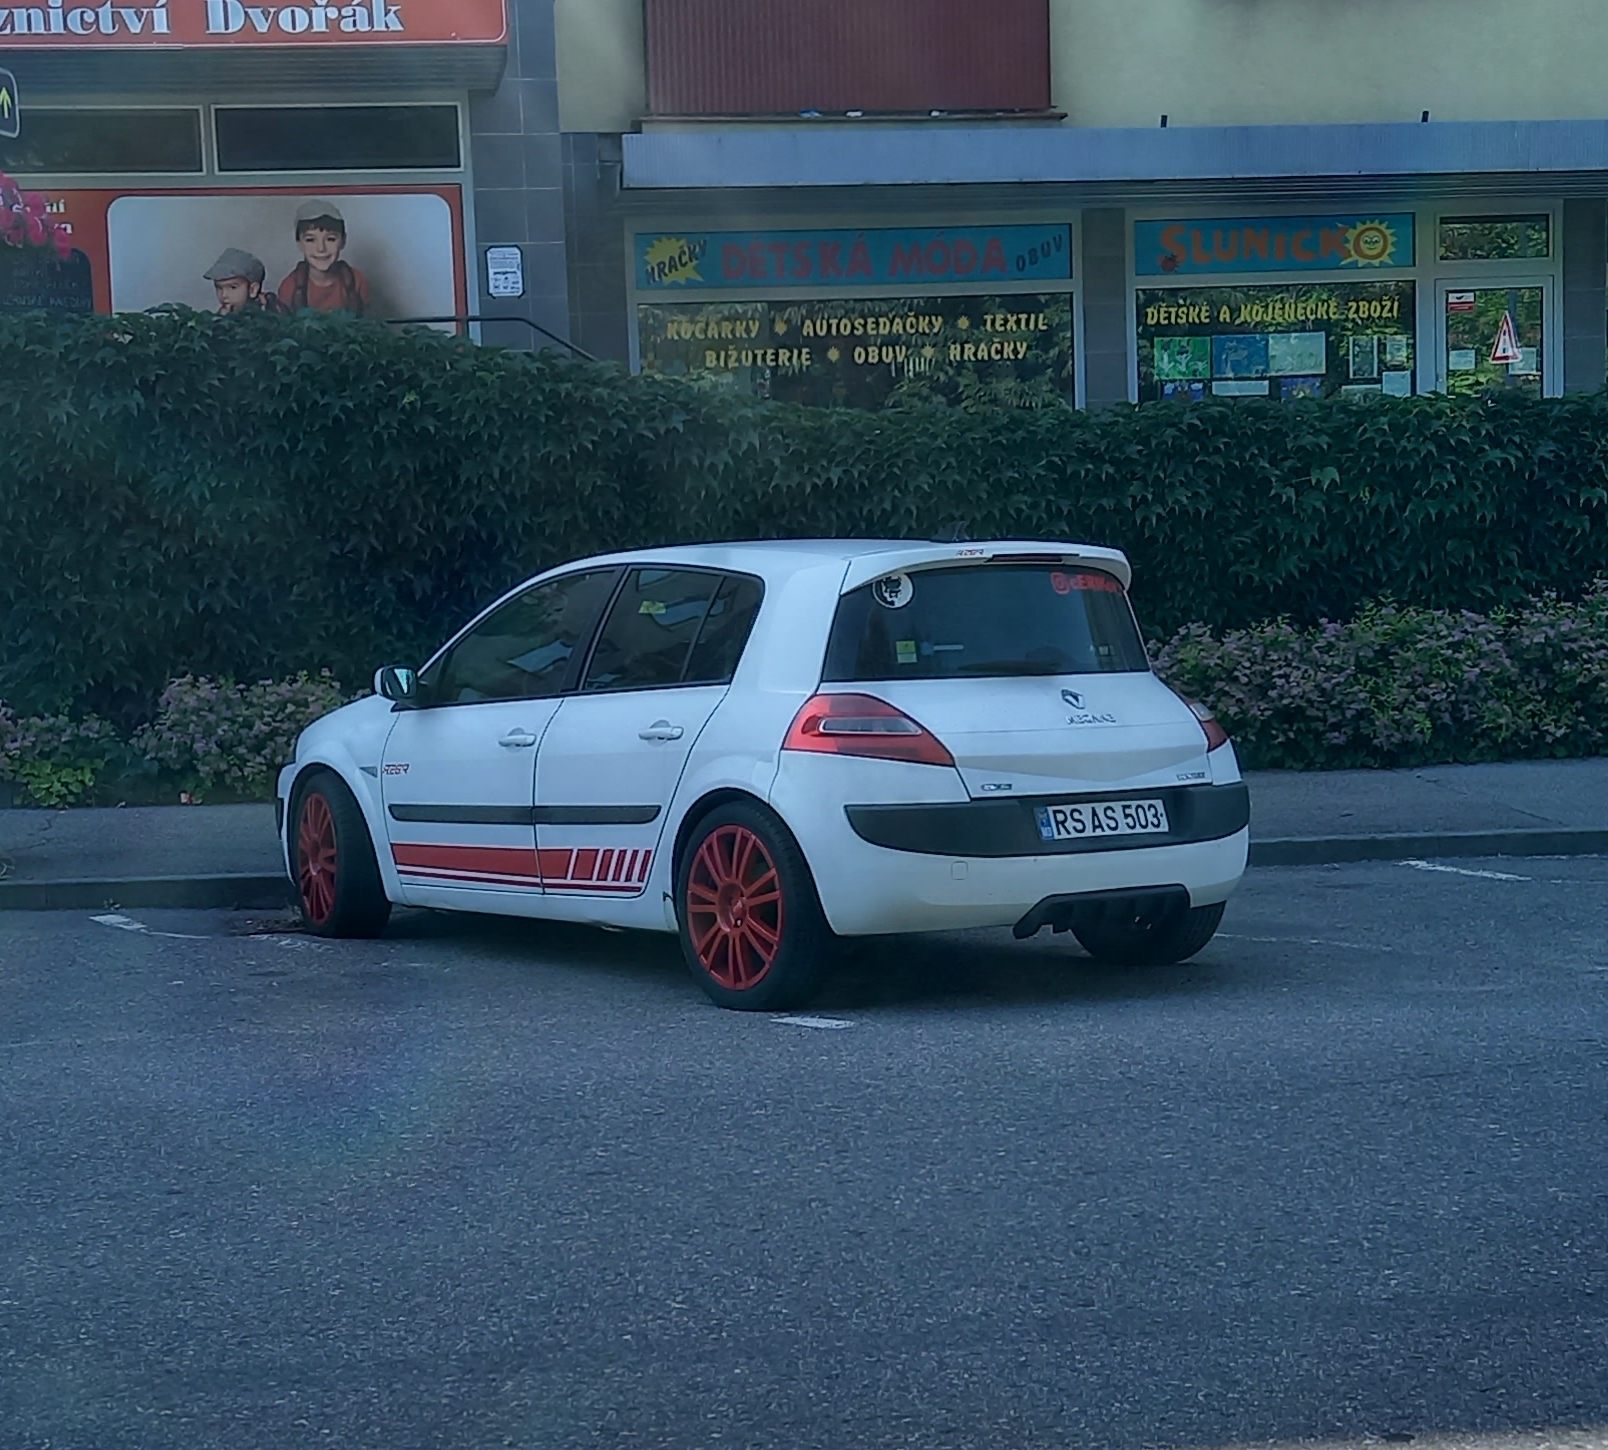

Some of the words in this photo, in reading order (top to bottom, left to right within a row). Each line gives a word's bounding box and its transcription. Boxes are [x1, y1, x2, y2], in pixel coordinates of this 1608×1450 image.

[206, 0, 404, 34] Dvořák
[645, 237, 708, 285] HRAČKY
[888, 231, 1008, 277] MÓDA
[1015, 233, 1063, 273] OBUV
[802, 312, 943, 338] AUTOSEDAČKY
[983, 313, 1049, 332] TEXTIL
[1219, 303, 1233, 323] A
[1348, 294, 1399, 319] ZBOŽÍ
[704, 344, 812, 369] BIŽUTERIE
[853, 345, 907, 365] OBUV
[949, 338, 1028, 362] HRAČKY
[1052, 807, 1086, 836] RS
[1091, 805, 1119, 833] AS
[1121, 803, 1161, 830] 503
